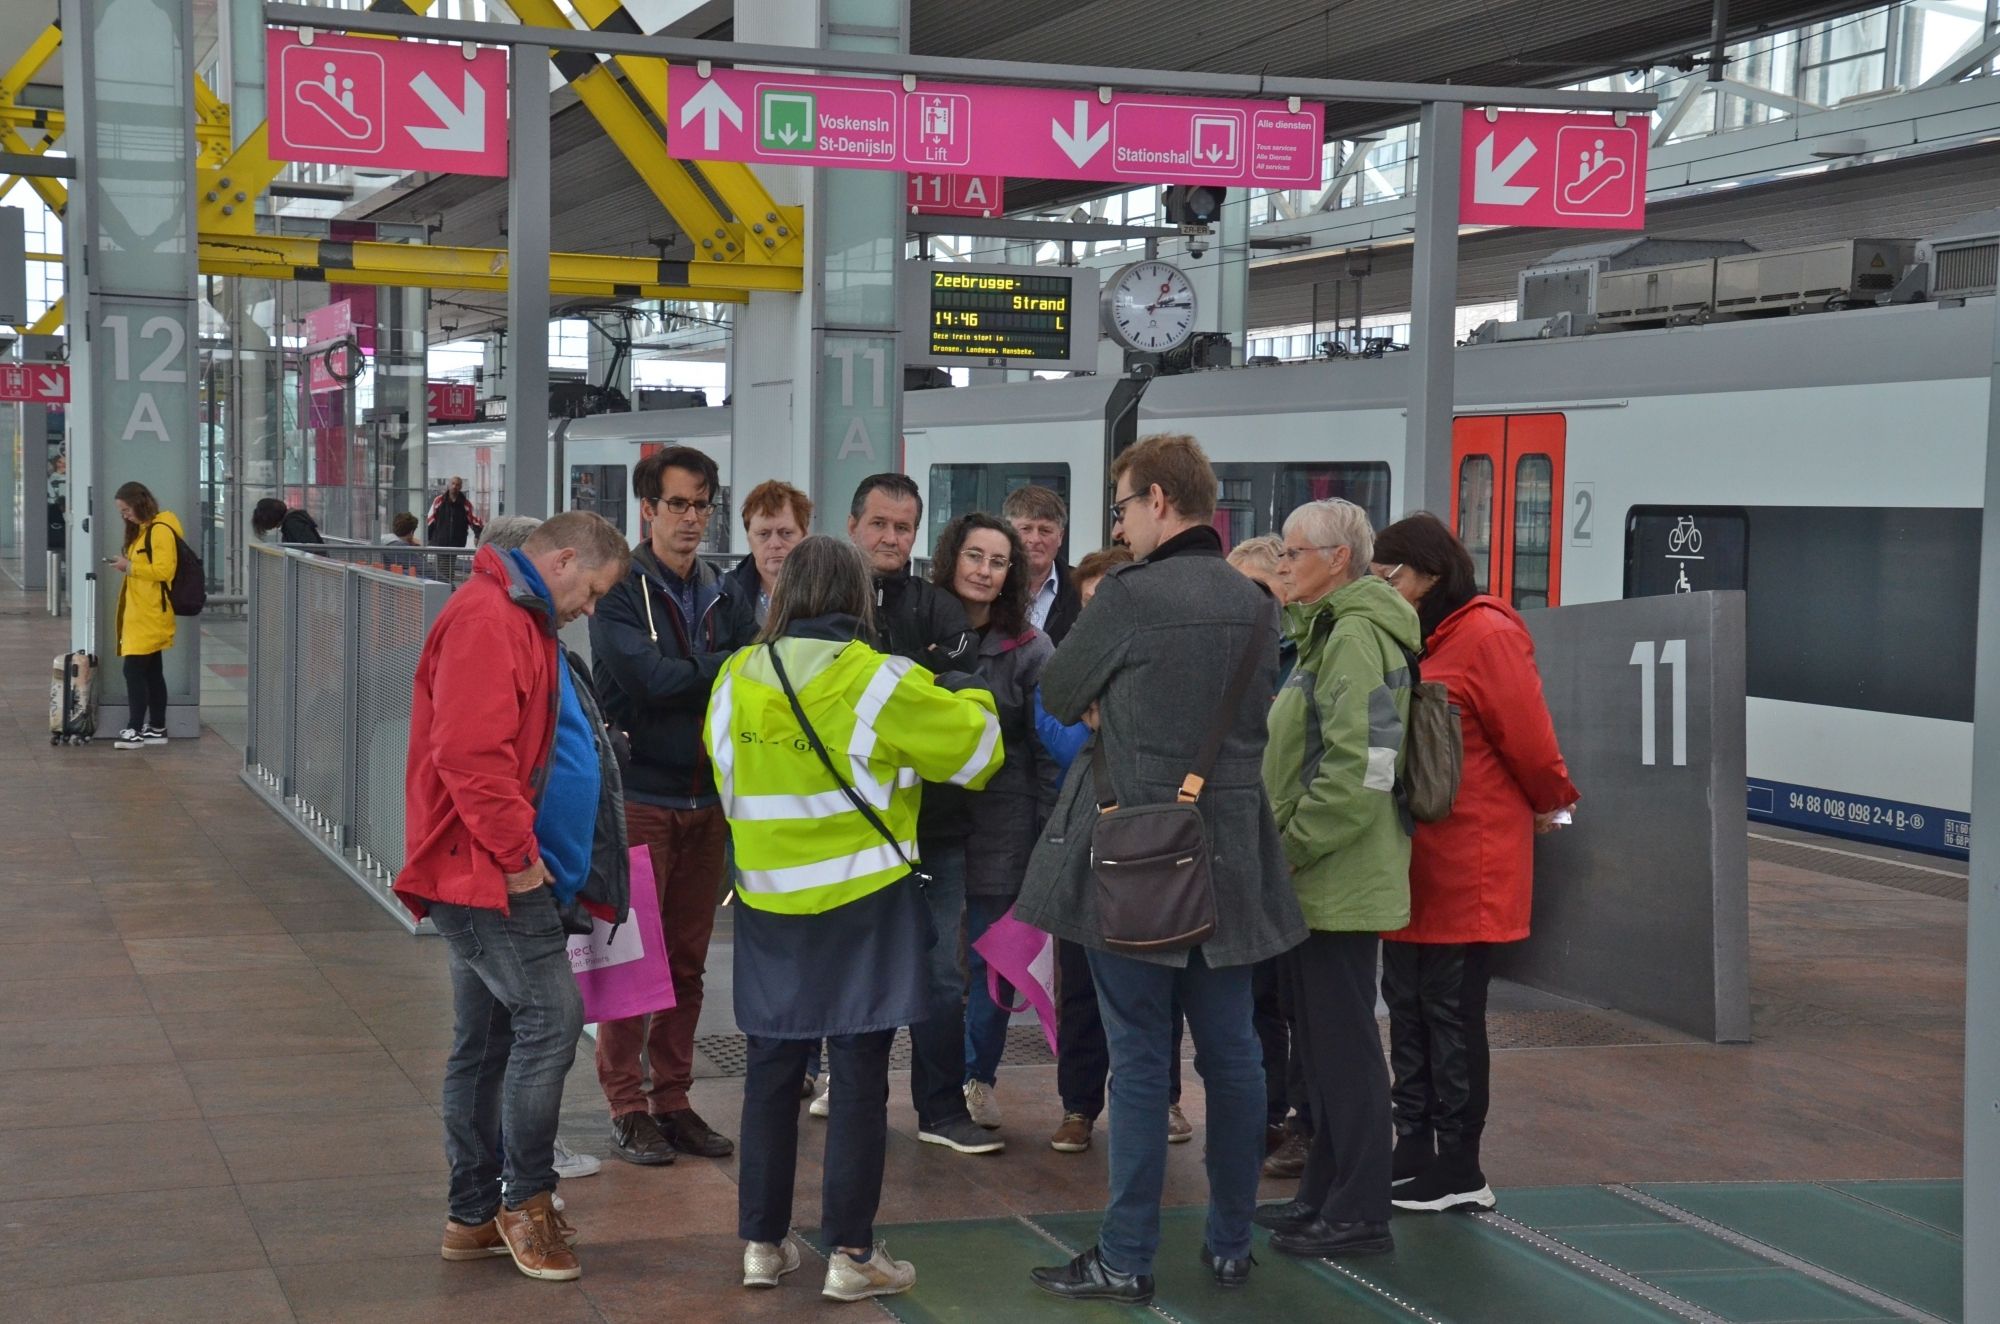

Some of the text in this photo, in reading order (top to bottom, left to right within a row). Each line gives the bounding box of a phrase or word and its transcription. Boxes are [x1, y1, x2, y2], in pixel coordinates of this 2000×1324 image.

[1257, 120, 1312, 130] Alle diensten
[925, 147, 948, 161] Lift
[1116, 147, 1190, 164] Stationshal
[911, 175, 987, 204] 11 A
[935, 273, 1021, 290] Zeebrugge-
[1013, 296, 1066, 311] Strand
[935, 311, 1064, 330] 14:46 L
[101, 315, 187, 383] 12
[831, 347, 885, 407] 11
[121, 392, 171, 442] A
[837, 416, 876, 461] A
[1573, 490, 1592, 540] 2
[1629, 639, 1687, 766] 11
[1790, 792, 1804, 810] 94
[1806, 795, 1821, 813] 88
[1823, 798, 1845, 818] 008
[1848, 802, 1871, 822] 098
[1873, 806, 1894, 826] 2-4
[570, 944, 595, 961] ject
